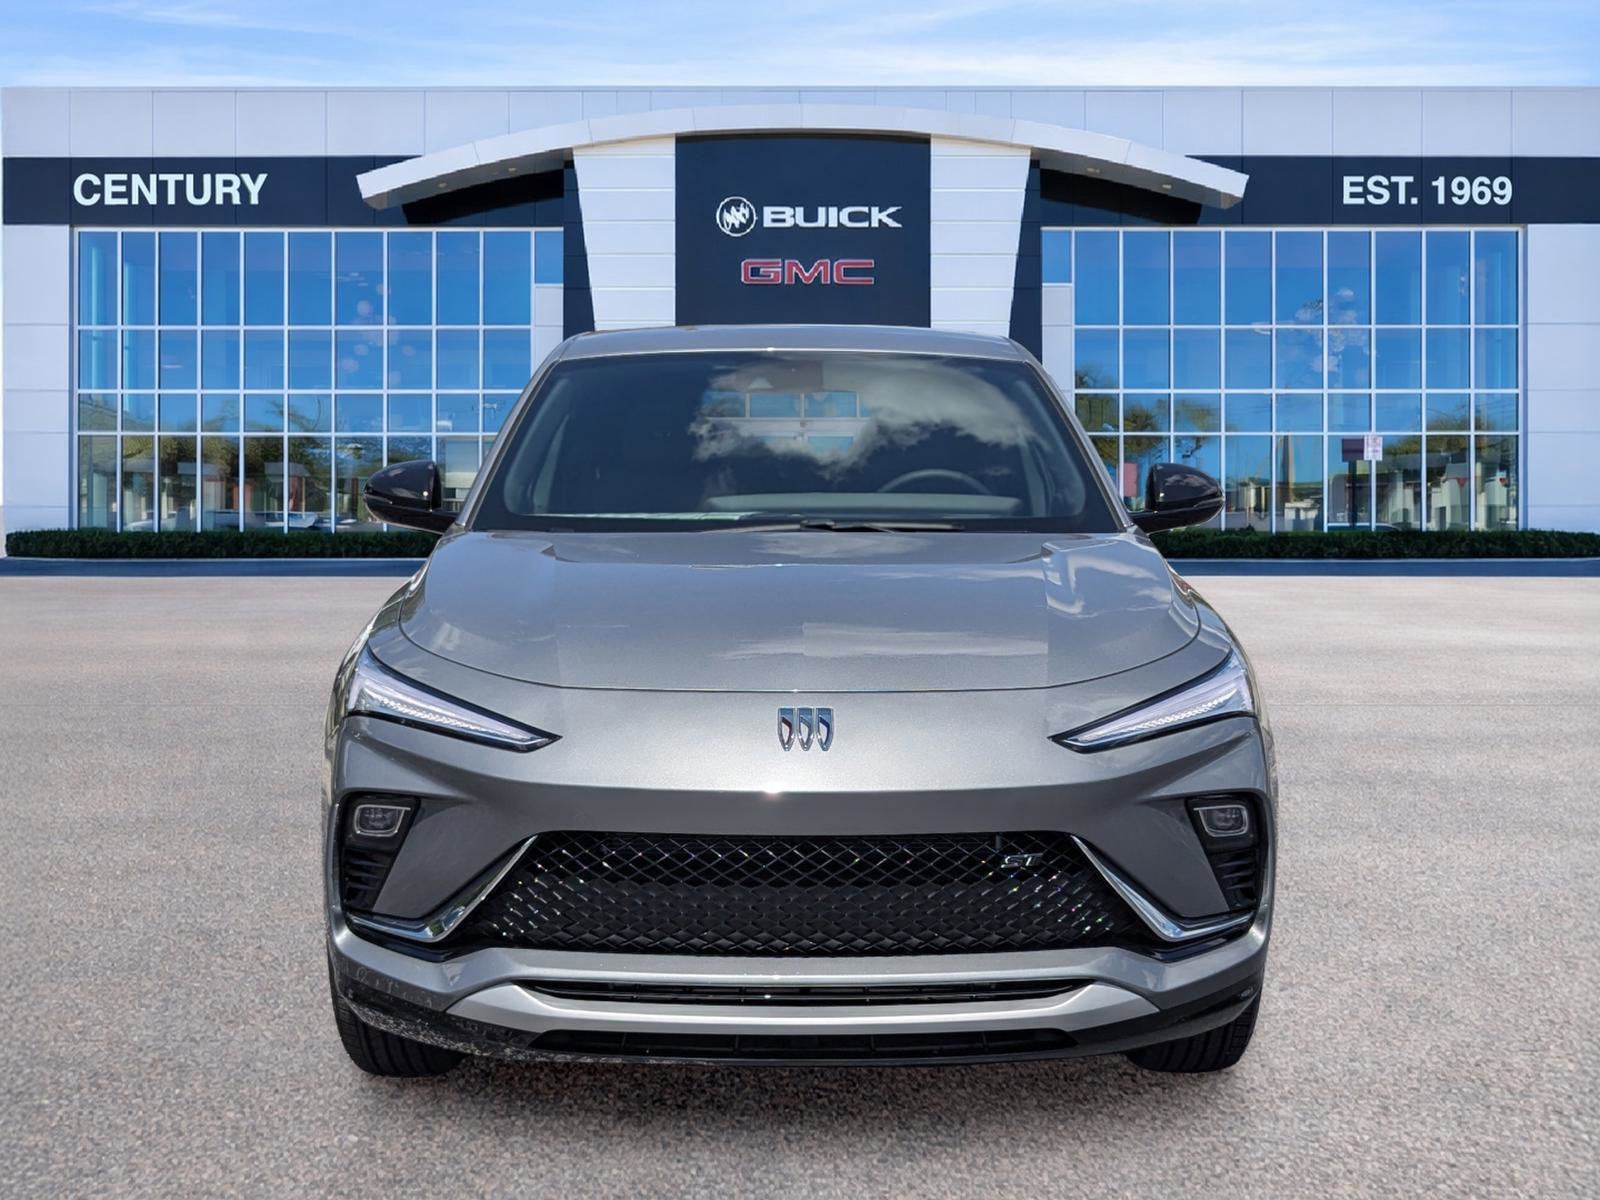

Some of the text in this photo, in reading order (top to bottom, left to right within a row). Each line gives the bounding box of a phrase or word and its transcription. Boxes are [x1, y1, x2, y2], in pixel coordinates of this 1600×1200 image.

[73, 173, 268, 206] CENTURY
[1342, 175, 1513, 205] EST. 1969
[762, 206, 903, 228] BUICK
[741, 258, 875, 285] GMC
